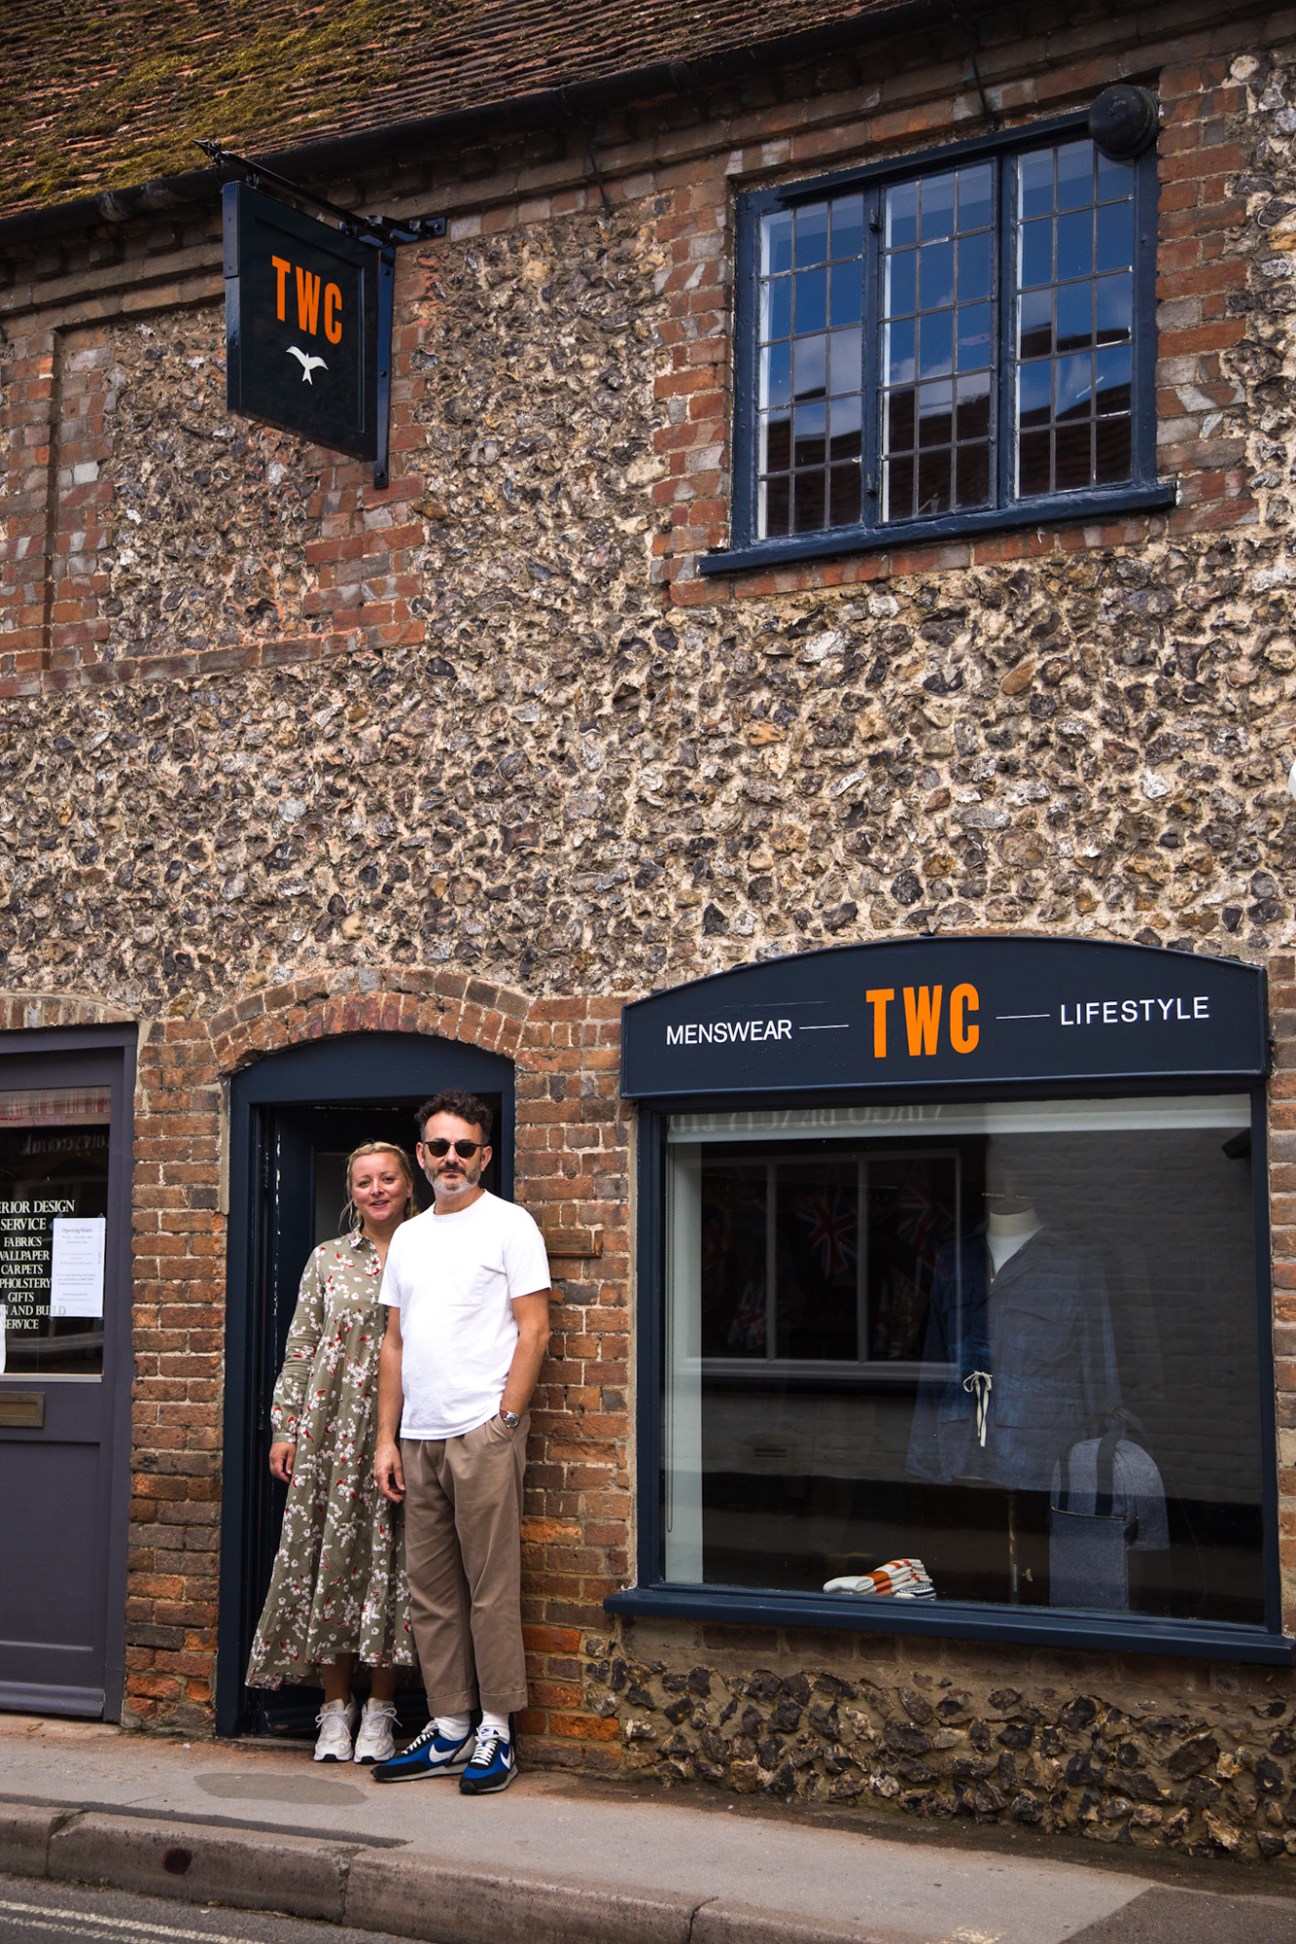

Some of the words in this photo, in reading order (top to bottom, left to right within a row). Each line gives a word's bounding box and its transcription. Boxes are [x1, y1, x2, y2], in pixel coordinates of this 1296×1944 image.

[271, 255, 342, 344] TWC
[666, 1019, 792, 1045] MENSWEAR
[866, 983, 980, 1058] TWC
[1060, 996, 1210, 1025] LIFESTYLE
[0, 1201, 31, 1214] RIOR
[33, 1200, 75, 1213] DESIGN
[0, 1217, 47, 1231] SERVICE
[3, 1236, 42, 1248] FABRICS
[1, 1264, 44, 1275] CARPETS
[7, 1292, 35, 1303] GIFTS
[10, 1305, 34, 1316] AND
